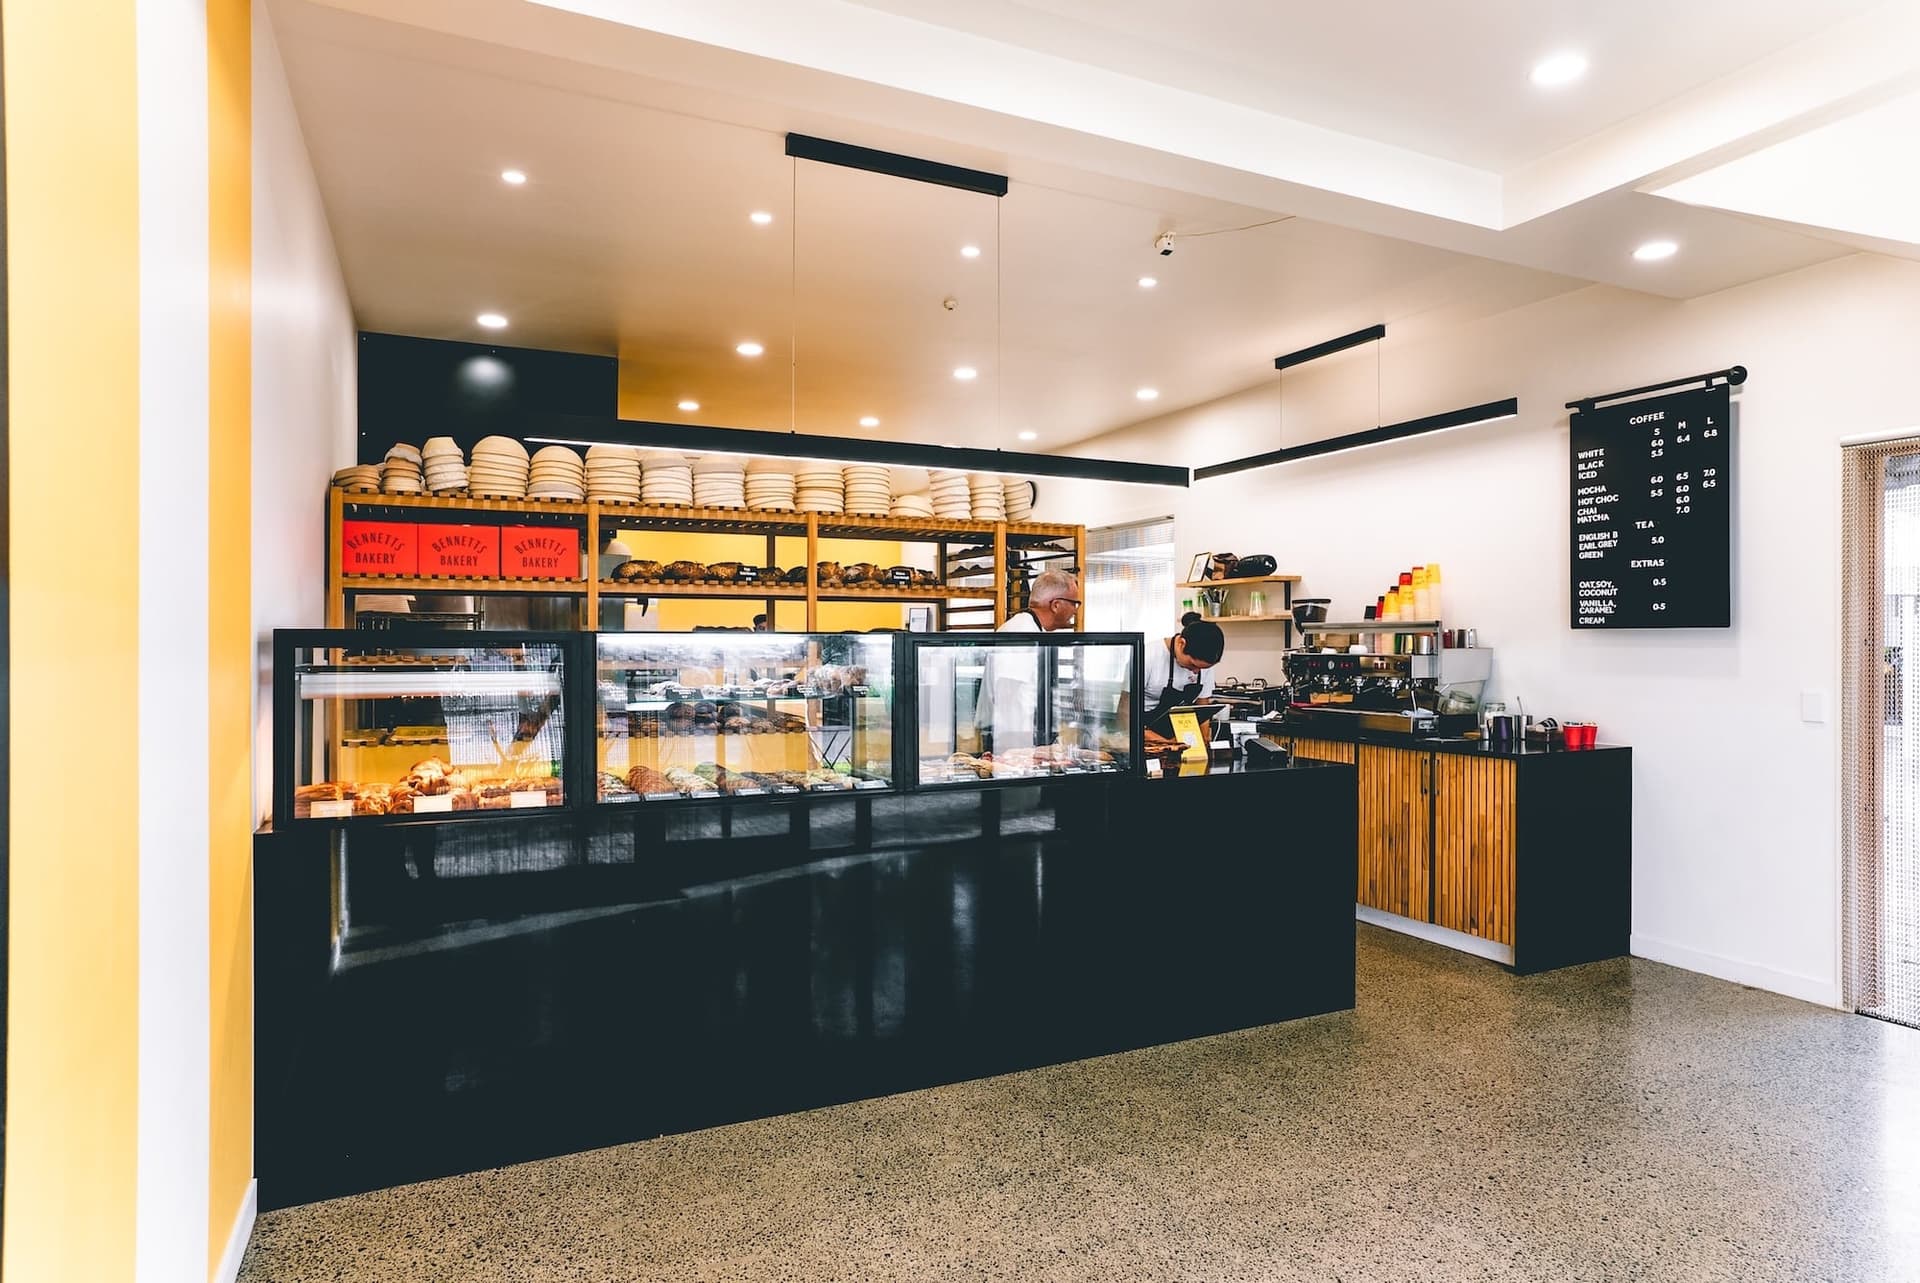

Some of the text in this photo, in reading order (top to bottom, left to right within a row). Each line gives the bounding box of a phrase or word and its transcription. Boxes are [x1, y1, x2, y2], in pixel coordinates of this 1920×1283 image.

[1629, 411, 1665, 425] COFFEE
[1653, 416, 1714, 436] S M L
[1577, 429, 1718, 460] WHITE 6.0 6.4 6.8
[1577, 448, 1664, 471] BLACK 5.5
[1578, 470, 1598, 480] ICED
[1577, 468, 1716, 496] MOCHA 6.0 6.5 7.0
[1577, 479, 1717, 507] HOT CHOC 5.5 6.0 6.5
[1577, 495, 1690, 516] CHAI 6.0
[1577, 506, 1690, 524] MATCHA 7.0
[1635, 520, 1655, 530] TEA
[346, 532, 405, 551] BENNETTS
[1578, 531, 1619, 542] ENGLISH B
[1578, 535, 1665, 551] EARL GREY 5.0
[431, 535, 488, 554] BENNETTS
[514, 537, 568, 556] BENNETTS
[355, 552, 396, 565] BAKERY
[440, 555, 478, 567] BAKERY
[1578, 550, 1604, 560] GREEN
[522, 556, 559, 568] BAKERY
[1630, 558, 1665, 568] EXTRAS
[1652, 577, 1667, 587] 0.5
[1578, 588, 1619, 597] COCONUT
[1578, 599, 1666, 611] VANILLA, 0.5
[1578, 606, 1616, 615] CARAMEL
[1578, 616, 1606, 625] CREAM
